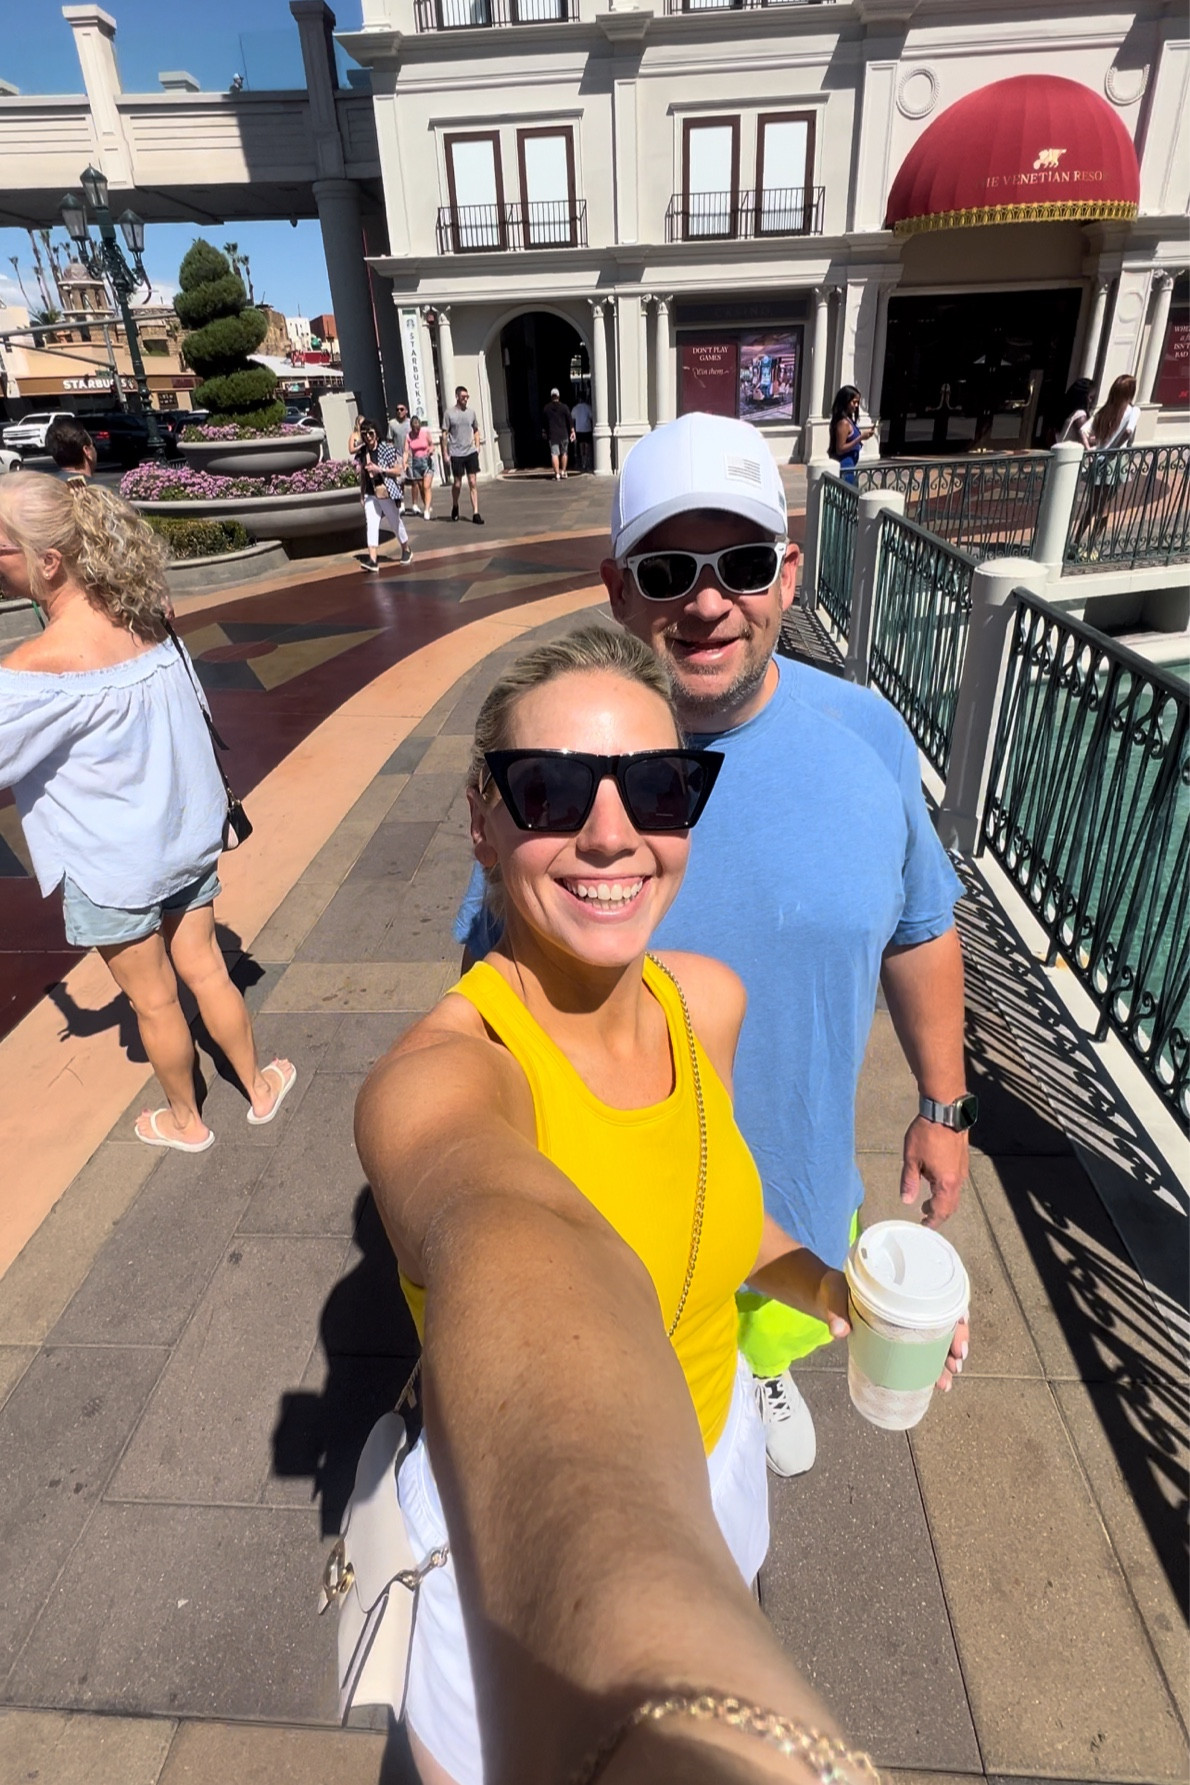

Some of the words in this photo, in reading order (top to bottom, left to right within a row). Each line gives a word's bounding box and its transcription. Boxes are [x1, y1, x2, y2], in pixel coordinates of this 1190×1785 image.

[1003, 171, 1070, 186] VENETIAN
[1073, 170, 1103, 183] RESO
[692, 346, 712, 354] DON'T
[410, 332, 421, 405] STARBUCKS
[63, 379, 126, 389] STARBUS
